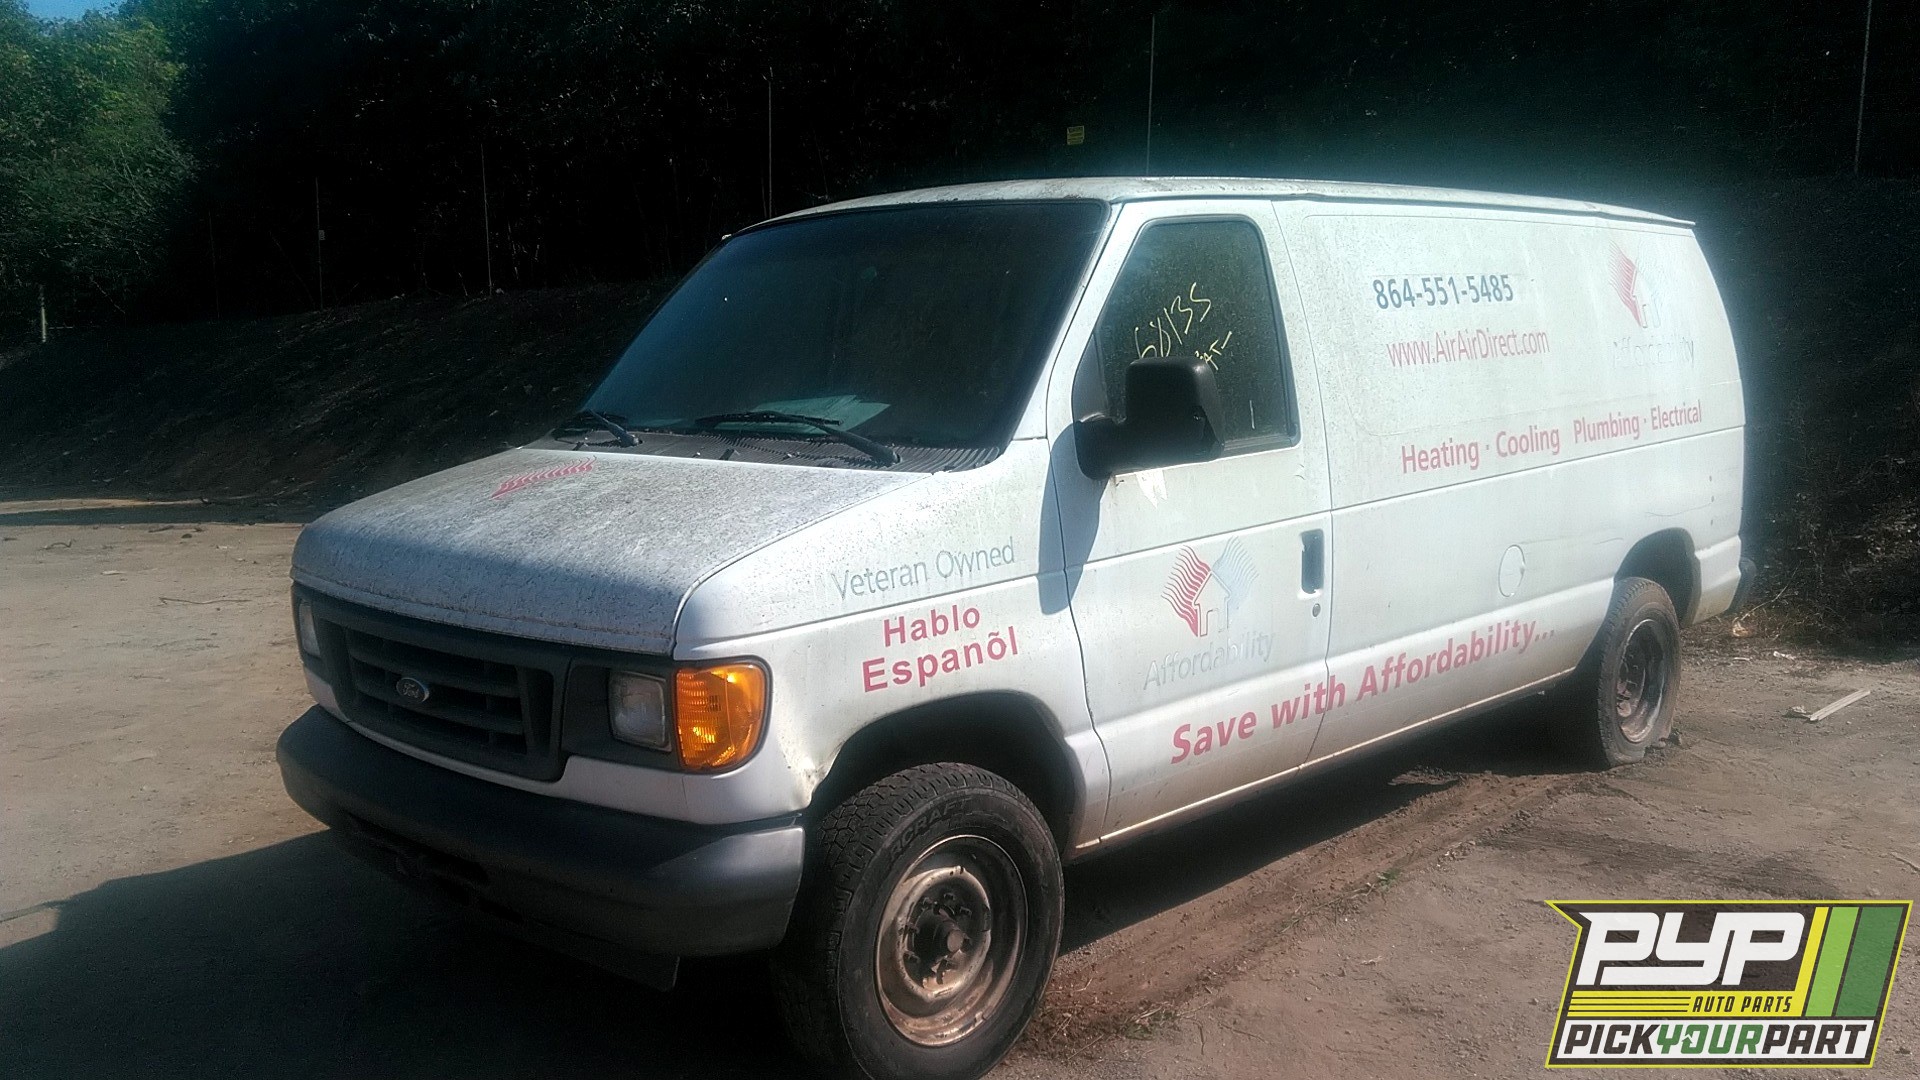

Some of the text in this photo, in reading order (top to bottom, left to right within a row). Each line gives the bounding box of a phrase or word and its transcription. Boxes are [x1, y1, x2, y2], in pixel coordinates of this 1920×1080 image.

[1372, 274, 1514, 309] 864-551-5485
[1386, 328, 1550, 368] www.AirAirDirect.com
[1401, 399, 1702, 474] Heating Cooling Plumbing Electrical
[831, 536, 1016, 600] Veteran Owned
[883, 604, 981, 647] Hablo
[1142, 630, 1277, 690] Affordability
[1171, 711, 1257, 764] Save
[1271, 674, 1346, 729] with
